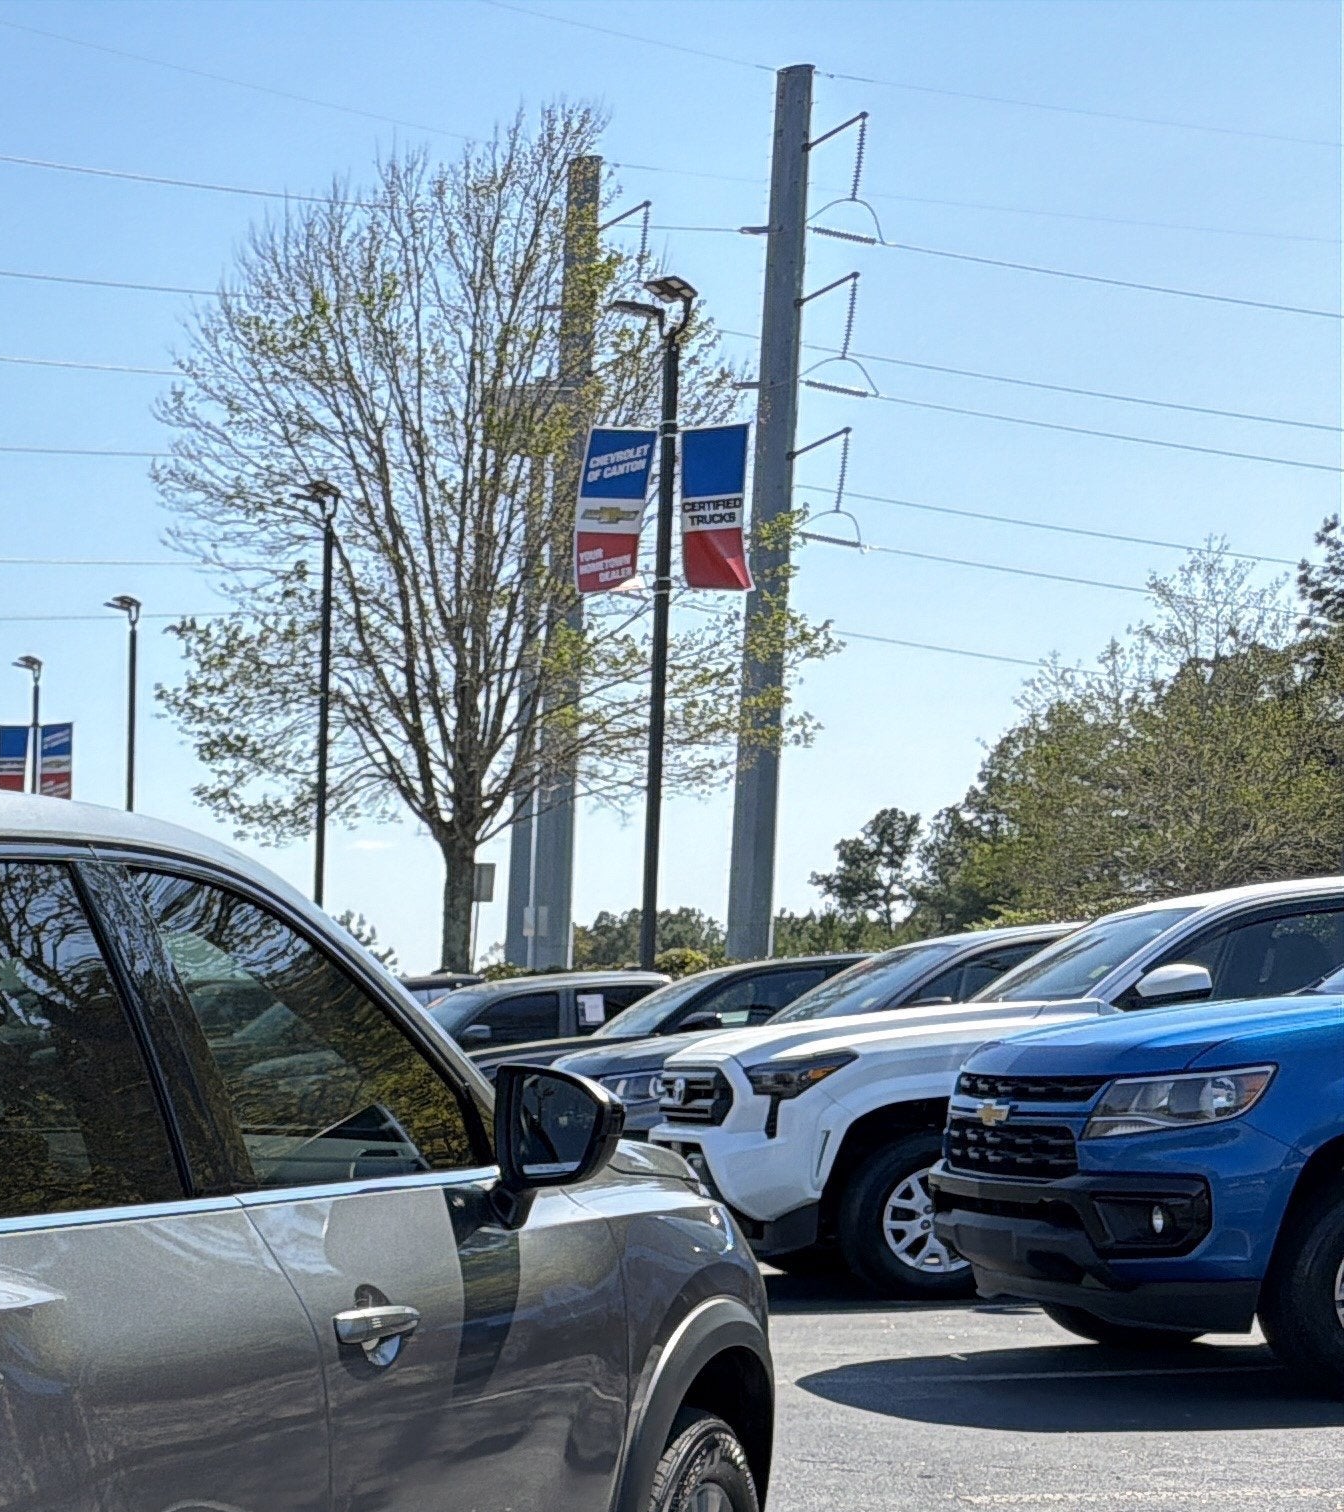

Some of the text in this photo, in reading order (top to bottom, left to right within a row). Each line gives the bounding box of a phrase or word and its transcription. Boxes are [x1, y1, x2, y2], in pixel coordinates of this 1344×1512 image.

[589, 443, 651, 469] CHEVROLET
[586, 458, 647, 483] OF CANTON
[681, 498, 742, 513] CERTIFIED
[689, 511, 736, 526] TRUCKS
